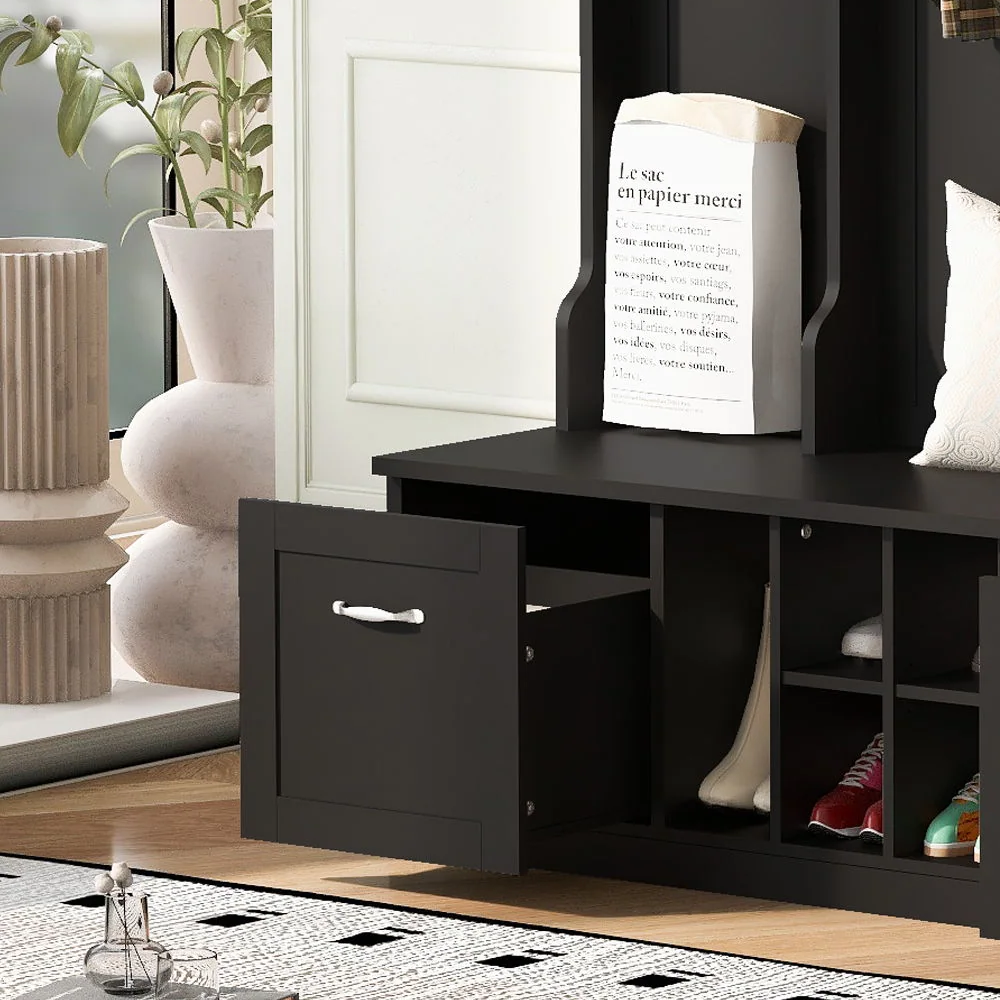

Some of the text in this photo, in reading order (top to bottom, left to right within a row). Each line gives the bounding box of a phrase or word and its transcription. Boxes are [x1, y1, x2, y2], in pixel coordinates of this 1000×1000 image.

[618, 162, 664, 183] Le sac
[617, 186, 742, 209] en papier merci
[614, 236, 741, 257] votre attention, votre jean,
[674, 259, 701, 269] votre
[614, 270, 629, 278] vos
[631, 271, 667, 284] espoirs,
[670, 276, 687, 285] vos
[659, 292, 685, 302] votre
[687, 292, 739, 308] confiance,
[613, 304, 635, 313] votre
[680, 328, 697, 336] vos
[699, 326, 731, 341] désirs,
[613, 337, 629, 346] vos
[659, 341, 676, 351] vos
[659, 359, 686, 369] votre
